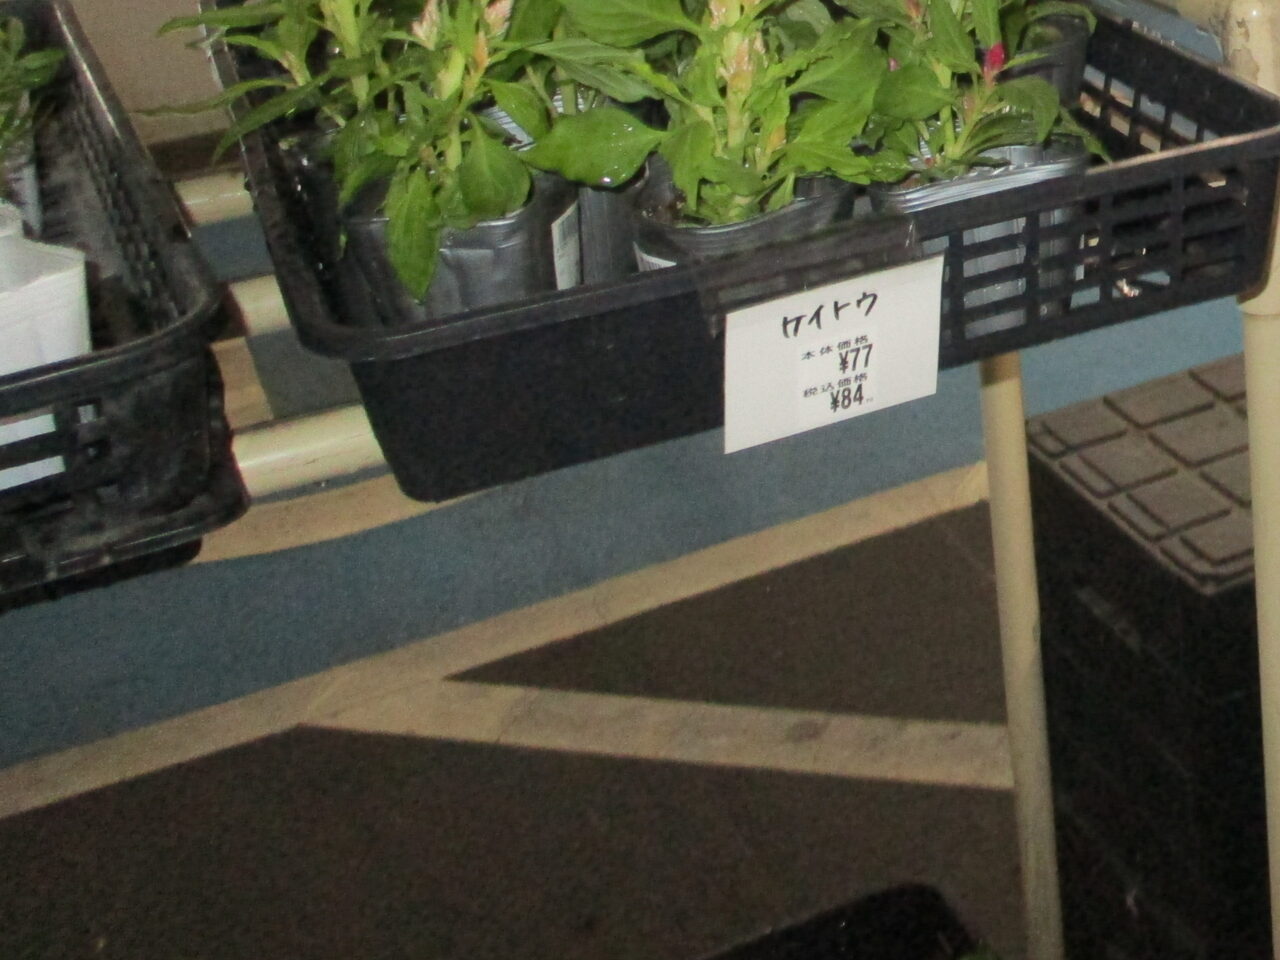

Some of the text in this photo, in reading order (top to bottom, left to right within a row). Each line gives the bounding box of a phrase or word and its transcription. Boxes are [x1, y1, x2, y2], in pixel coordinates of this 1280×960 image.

[782, 292, 878, 338] ケイトウ
[839, 344, 873, 374] ¥77
[830, 384, 864, 413] ¥84
